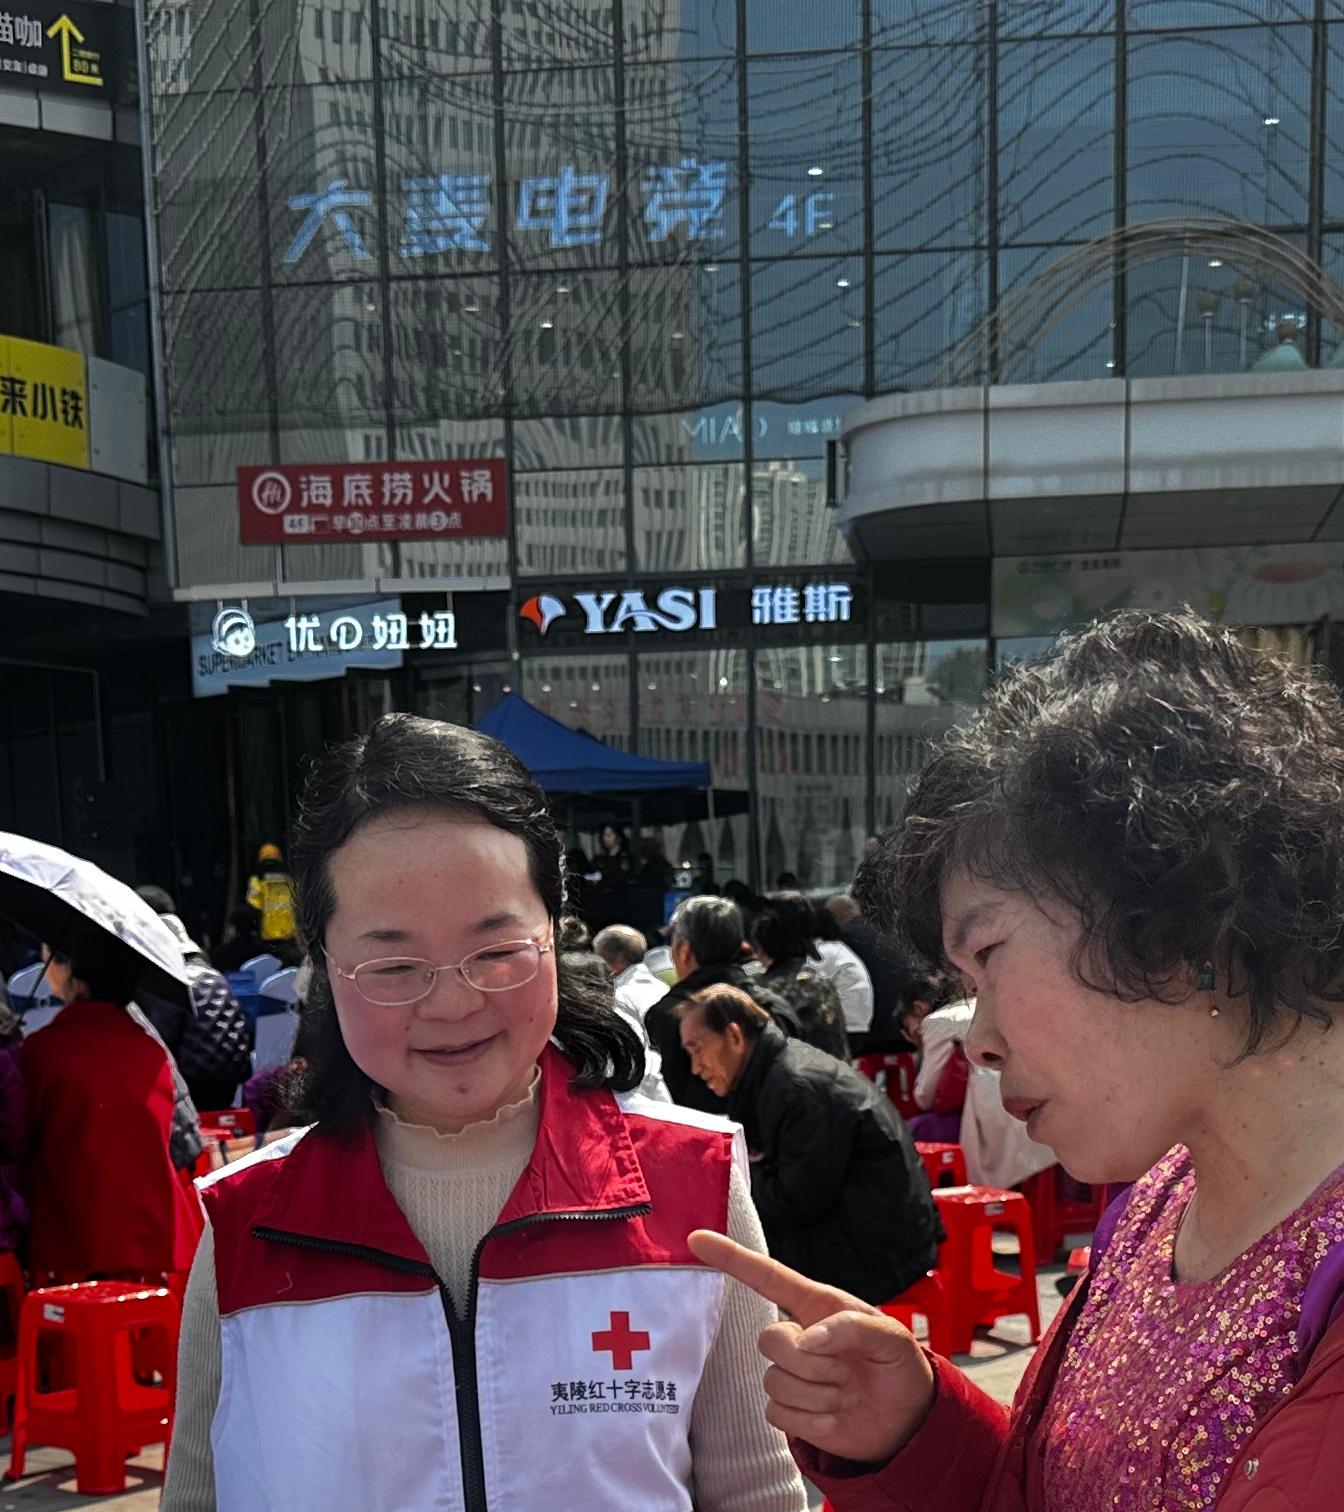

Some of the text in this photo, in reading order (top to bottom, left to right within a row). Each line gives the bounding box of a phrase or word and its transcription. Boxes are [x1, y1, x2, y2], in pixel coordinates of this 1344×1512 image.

[768, 191, 835, 239] 4F
[298, 469, 494, 508] 海底捞火锅
[574, 584, 854, 635] YASI 雅斯
[549, 1378, 678, 1402] 夷陵红十字志愿者
[549, 1402, 643, 1416] YILING RED CROSS
